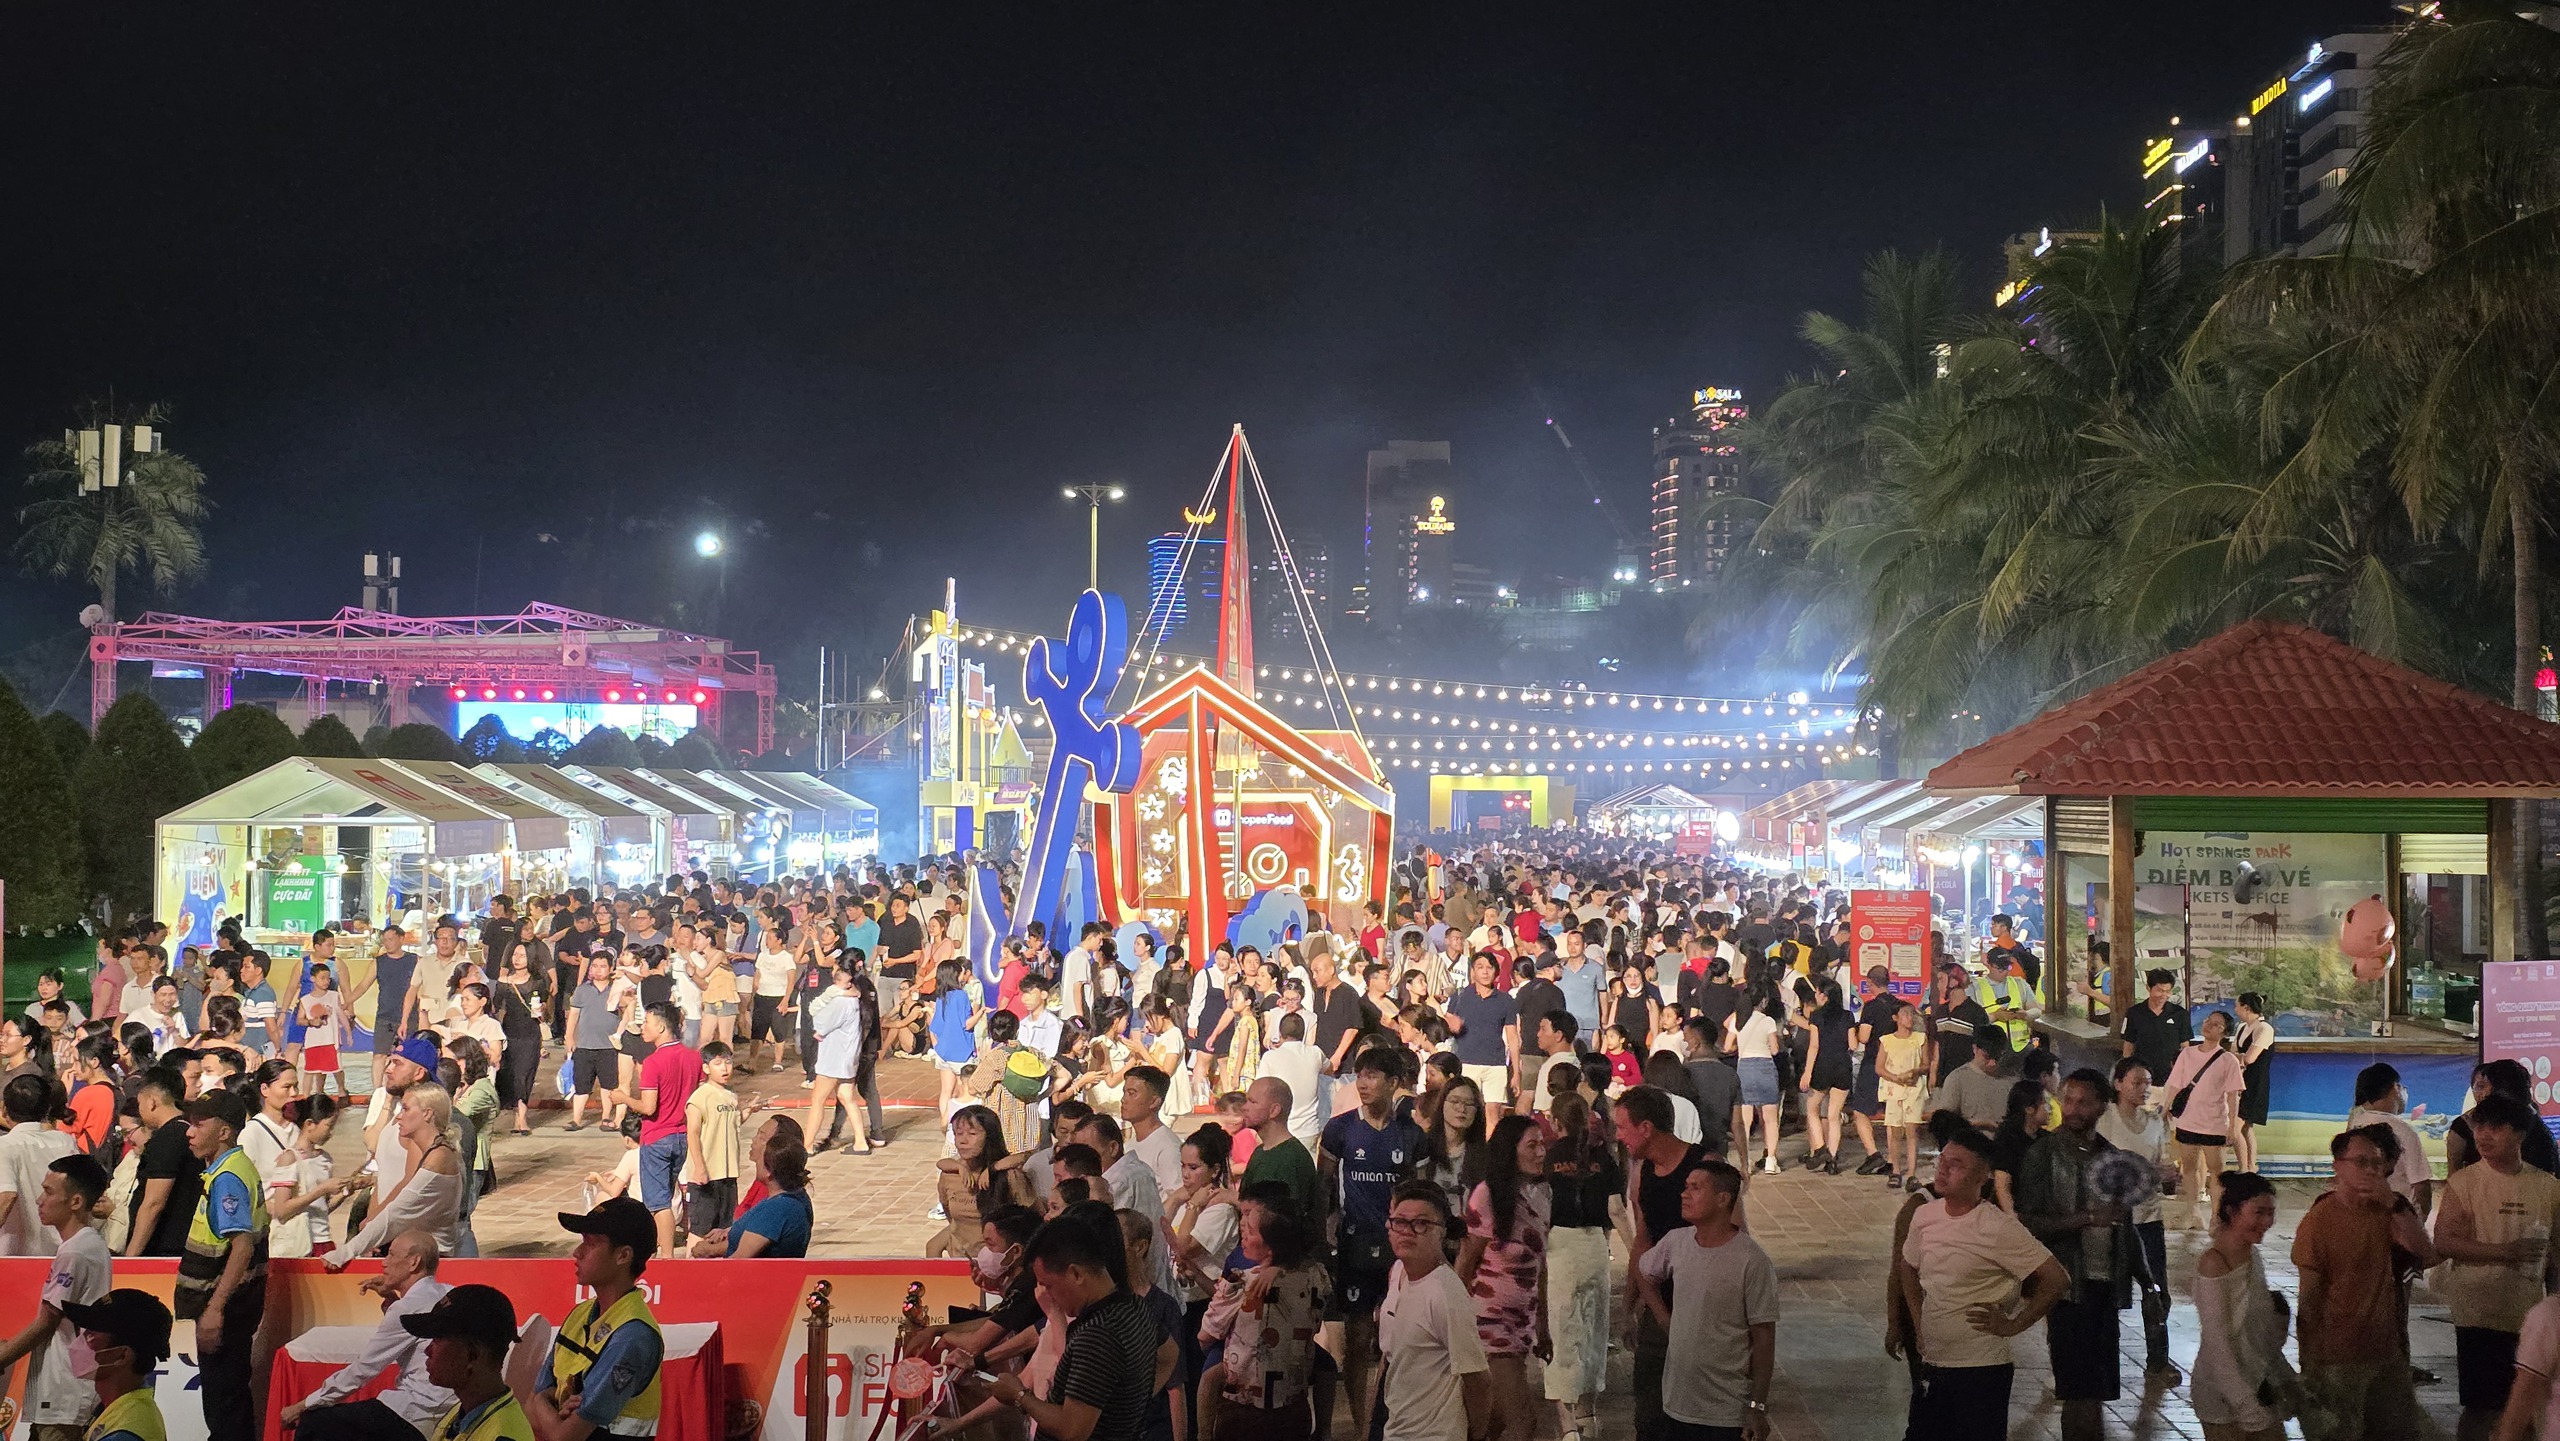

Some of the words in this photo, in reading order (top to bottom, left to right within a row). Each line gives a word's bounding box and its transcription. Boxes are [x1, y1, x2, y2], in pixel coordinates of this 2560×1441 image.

[2148, 859, 2211, 886] ĐIỂM
[2280, 866, 2311, 887] VÉ
[831, 1315, 852, 1324] NHÀ
[853, 1315, 868, 1324] TÀI
[870, 1315, 890, 1326] TRỢ
